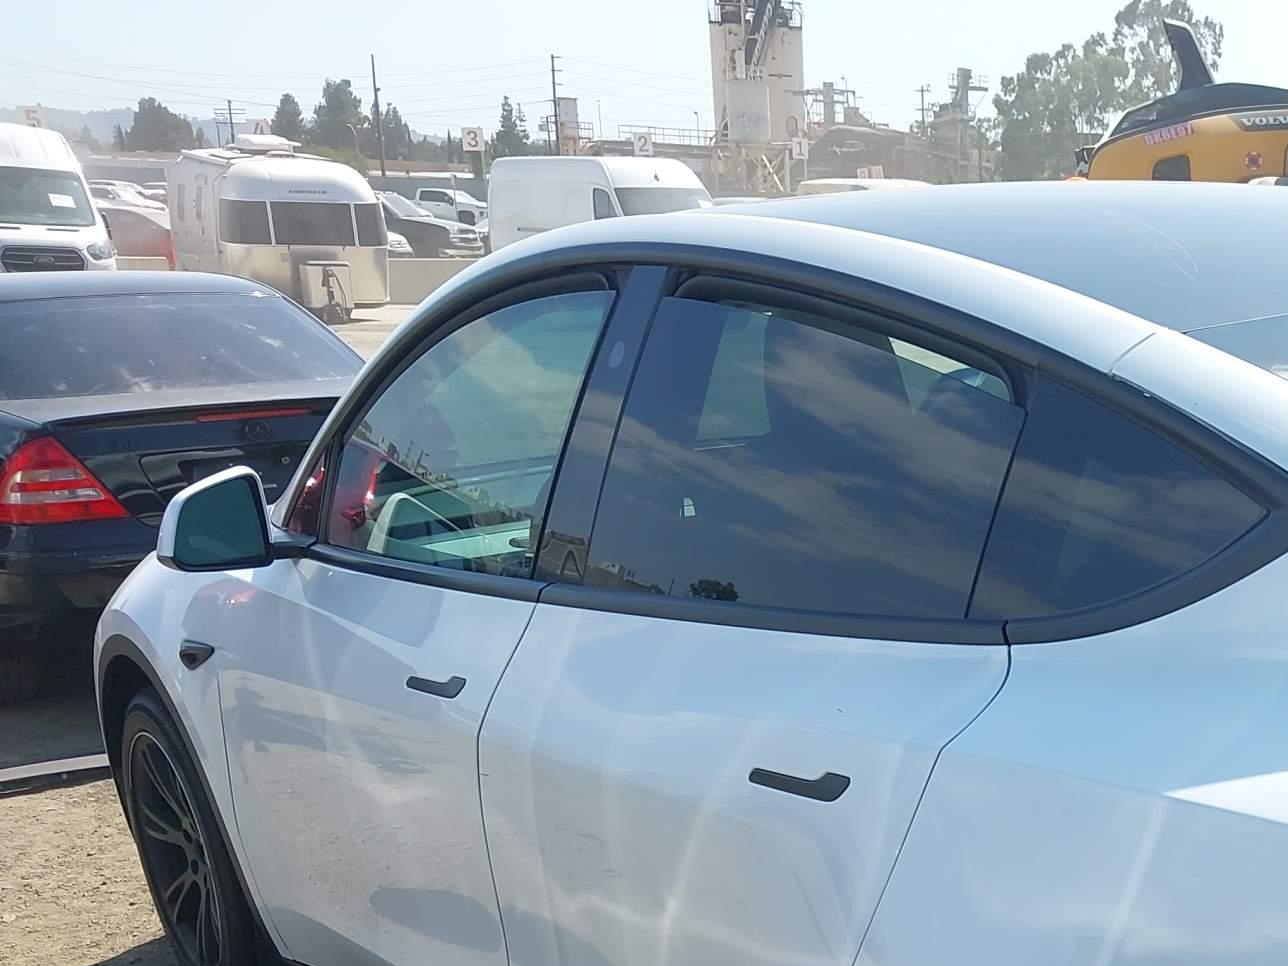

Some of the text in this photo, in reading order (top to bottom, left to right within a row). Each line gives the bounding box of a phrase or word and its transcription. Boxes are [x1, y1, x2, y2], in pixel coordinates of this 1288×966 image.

[465, 130, 480, 148] 3
[637, 135, 650, 153] 2
[796, 141, 804, 157] 1
